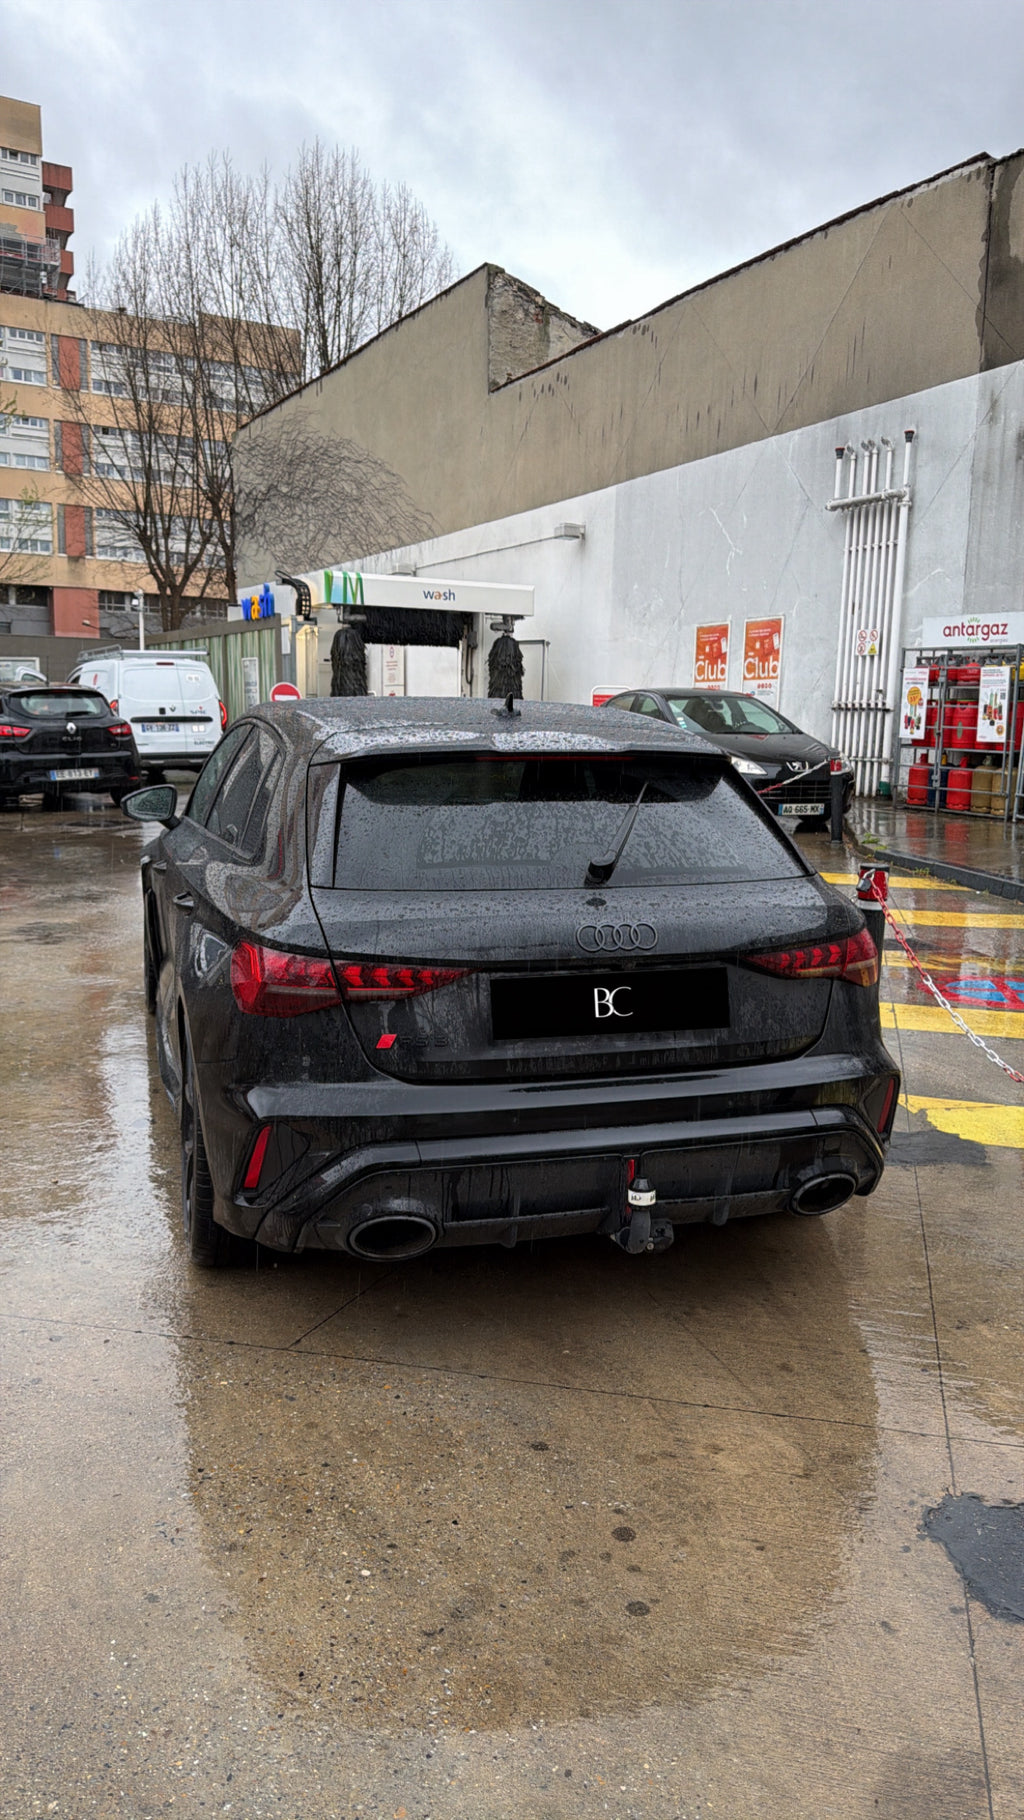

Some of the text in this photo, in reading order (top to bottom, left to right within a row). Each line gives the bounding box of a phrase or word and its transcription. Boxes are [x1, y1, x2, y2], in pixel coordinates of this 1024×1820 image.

[422, 588, 456, 601] wash
[943, 622, 1008, 641] antargaz
[695, 659, 726, 681] Club
[744, 655, 779, 679] Club
